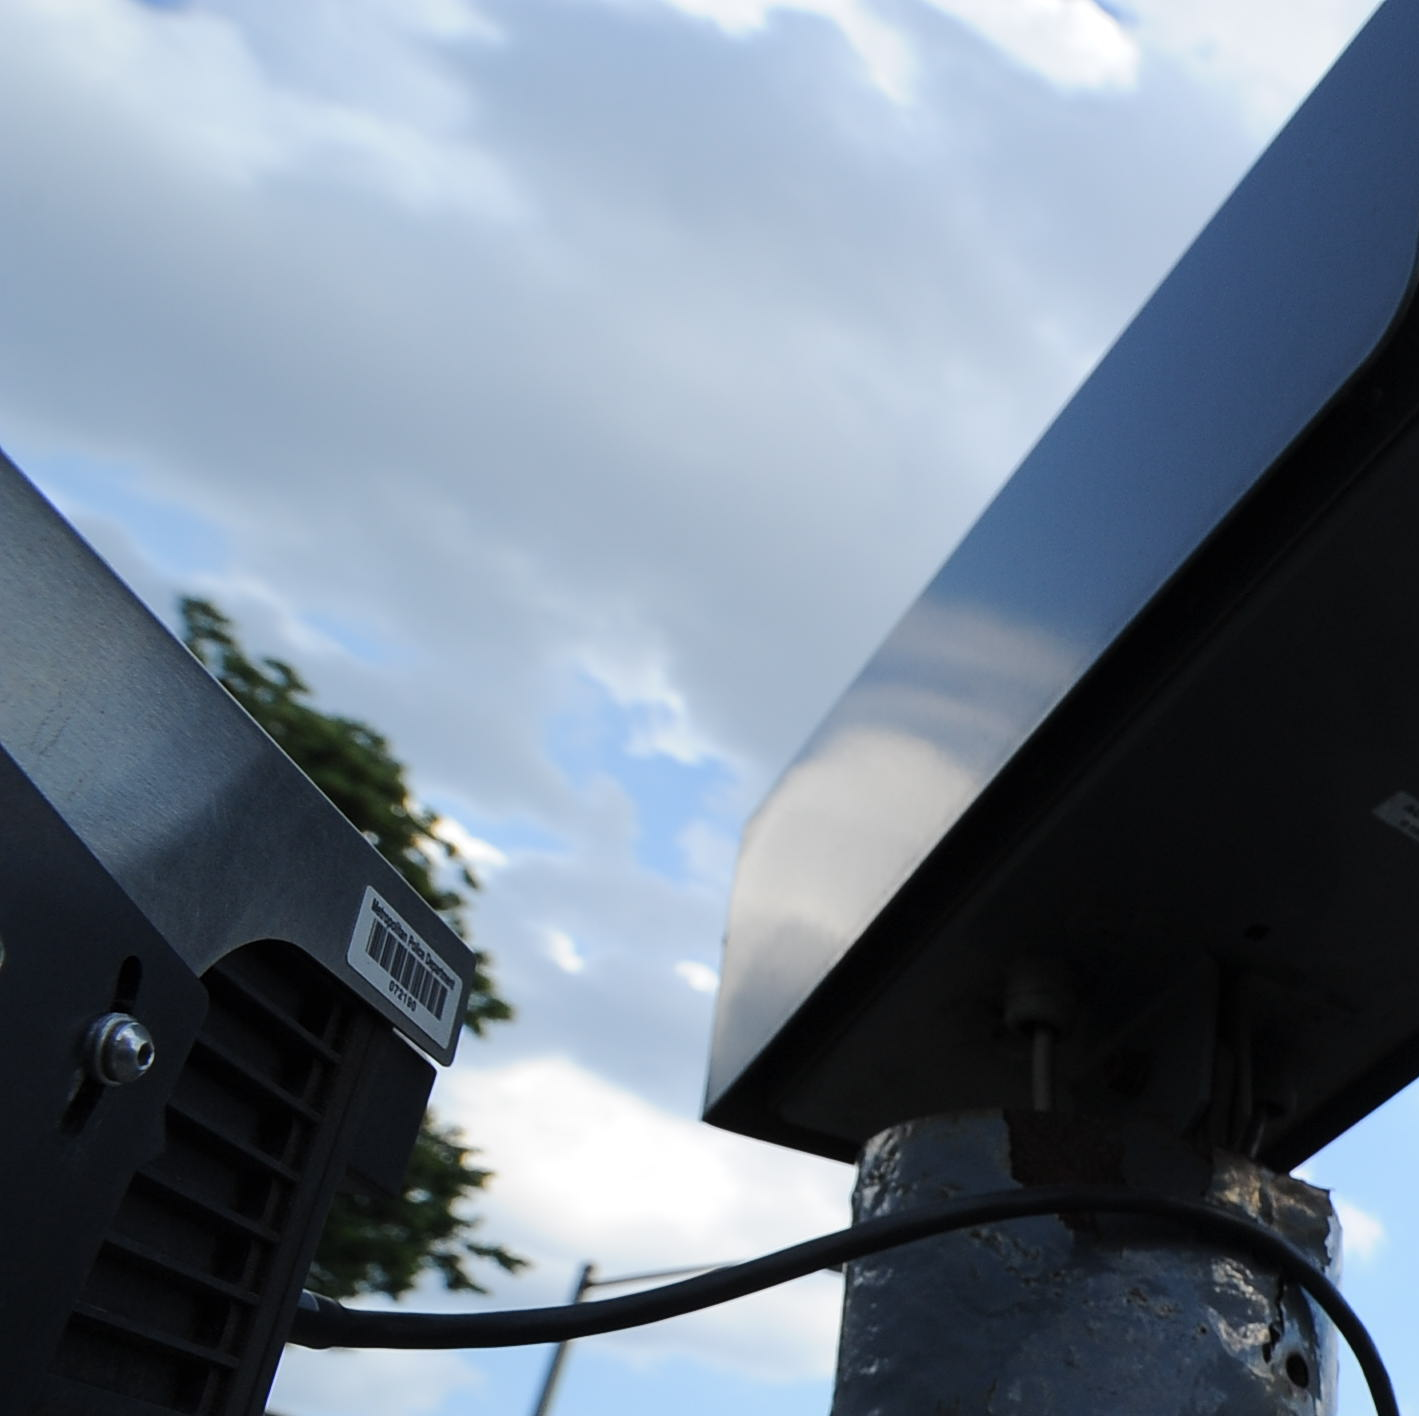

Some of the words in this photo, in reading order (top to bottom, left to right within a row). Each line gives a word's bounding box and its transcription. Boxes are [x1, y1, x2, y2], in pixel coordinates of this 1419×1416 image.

[371, 898, 408, 942] Metropolitan
[408, 935, 424, 961] Police
[425, 952, 456, 991] Department
